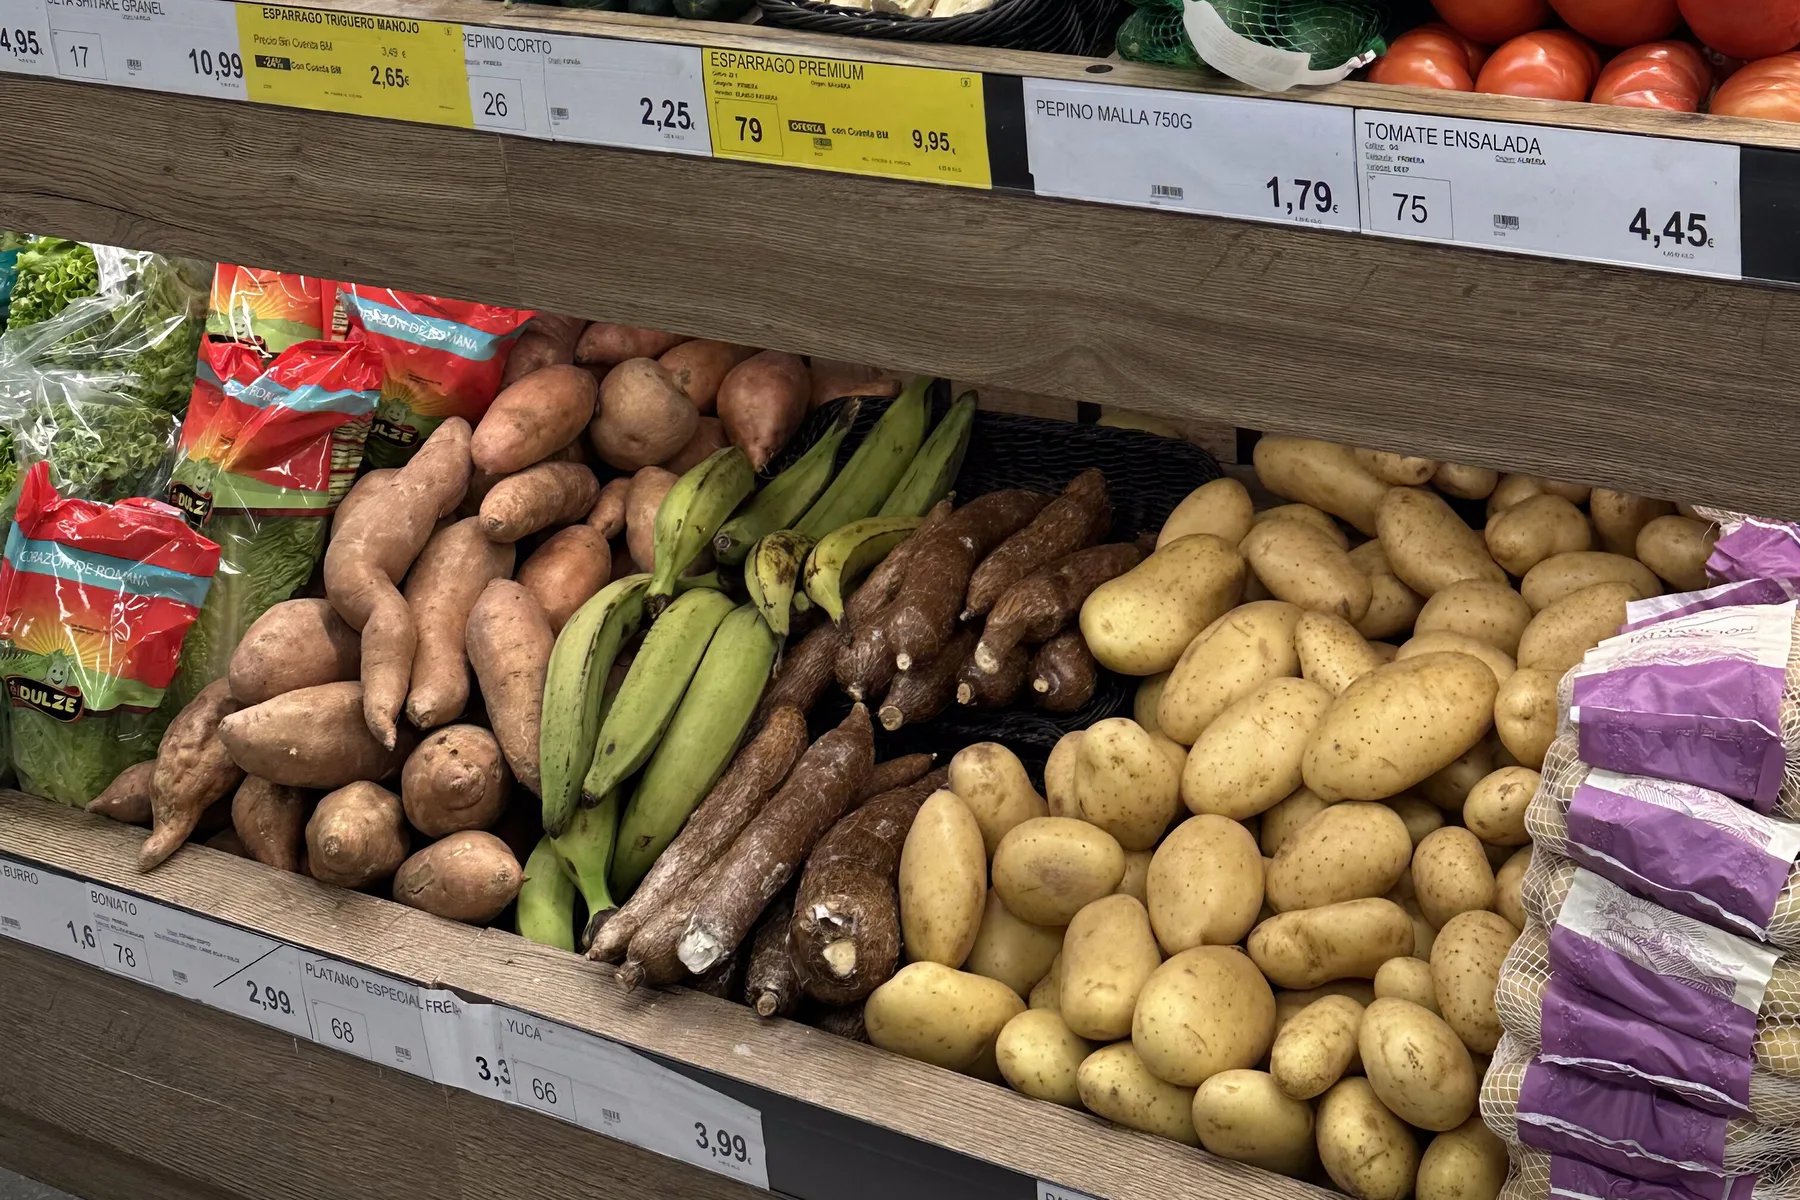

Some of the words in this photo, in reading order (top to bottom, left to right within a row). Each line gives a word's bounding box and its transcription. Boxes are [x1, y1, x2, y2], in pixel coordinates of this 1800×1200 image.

[262, 7, 322, 24] ESPARRAGO
[324, 13, 375, 31] TRIGUERO
[377, 18, 419, 34] MANOJO
[253, 34, 278, 46] Precio
[381, 46, 398, 58] 3,49
[507, 37, 552, 55] CORTO
[70, 45, 88, 68] 17
[189, 48, 243, 81] 10,99
[711, 51, 795, 74] ESPARRAGO
[799, 60, 865, 81] PREMIUM
[483, 91, 508, 117] 26
[1036, 100, 1093, 119] PEPINO
[1097, 105, 1149, 125] MALLA
[1152, 111, 1192, 129] 750G
[735, 116, 763, 143] 79
[791, 122, 823, 133] OFERTA
[832, 127, 847, 135] con
[848, 128, 875, 138] Cuenta
[1364, 121, 1438, 145] TOMATE
[1443, 129, 1542, 156] ENSALADA
[1392, 192, 1428, 224] 75
[371, 423, 415, 443] ULZE
[178, 492, 208, 516] DULZ
[20, 684, 77, 714] DULZE
[3, 865, 38, 885] BURRO
[91, 890, 137, 916] BONIATO
[113, 943, 136, 967] 78
[305, 962, 359, 990] PLATANO
[331, 1017, 354, 1044] 68
[506, 1018, 542, 1041] YUCA
[532, 1077, 557, 1104] 66
